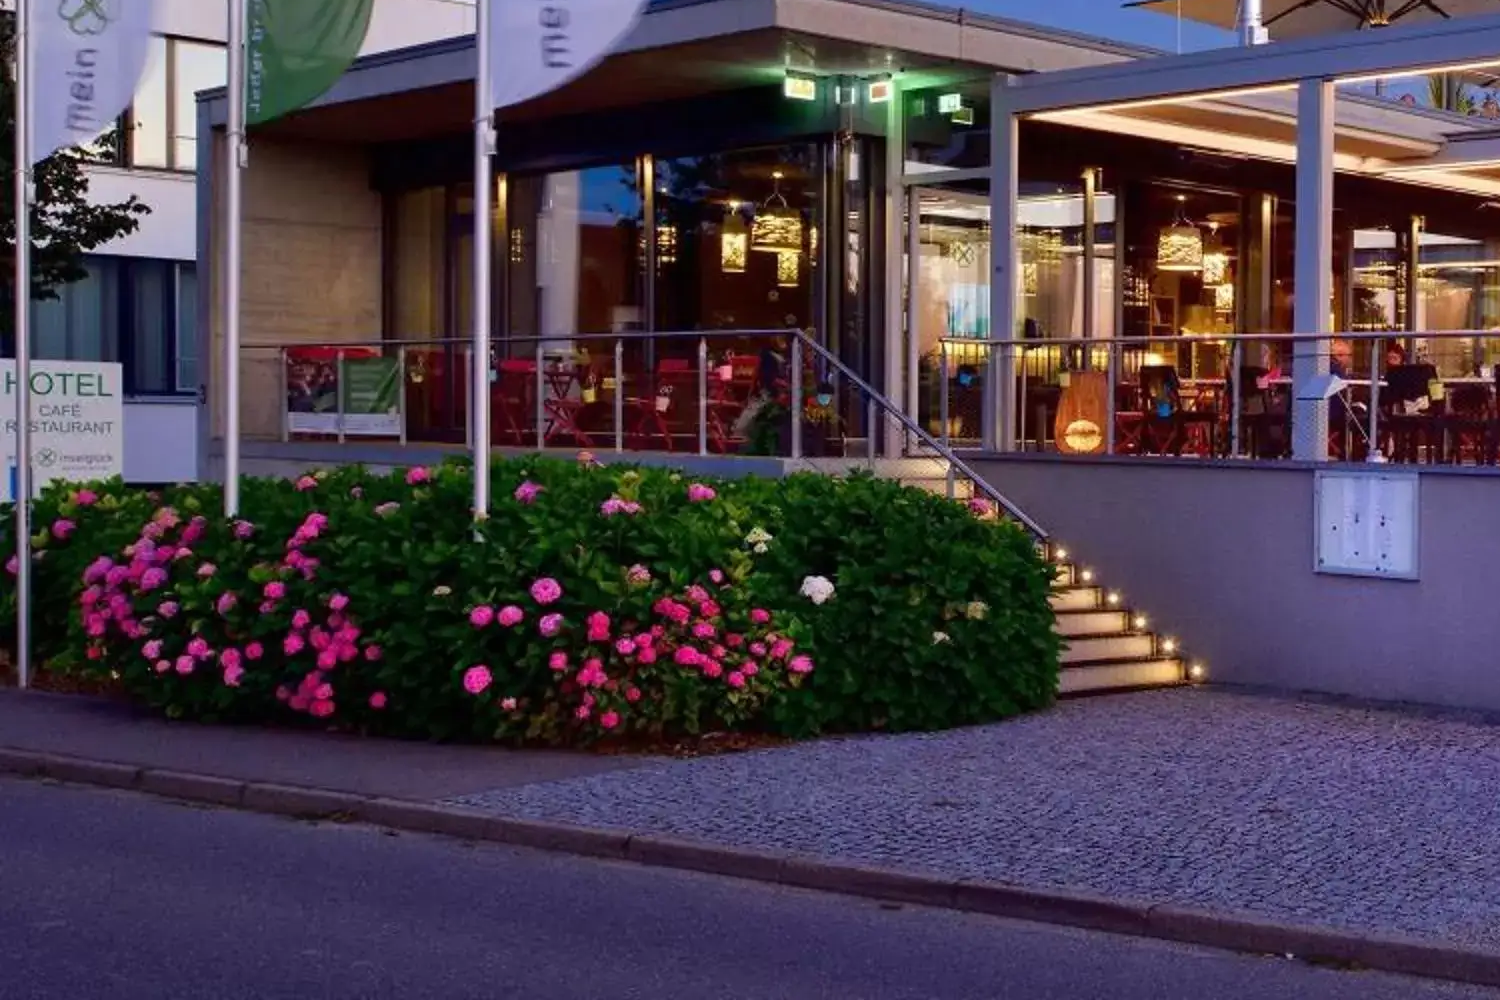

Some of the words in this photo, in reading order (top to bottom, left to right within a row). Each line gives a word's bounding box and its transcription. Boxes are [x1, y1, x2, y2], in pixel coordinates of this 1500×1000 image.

[64, 48, 99, 133] mein
[4, 371, 113, 397] HOTEL
[5, 419, 114, 434] RSTAURANT
